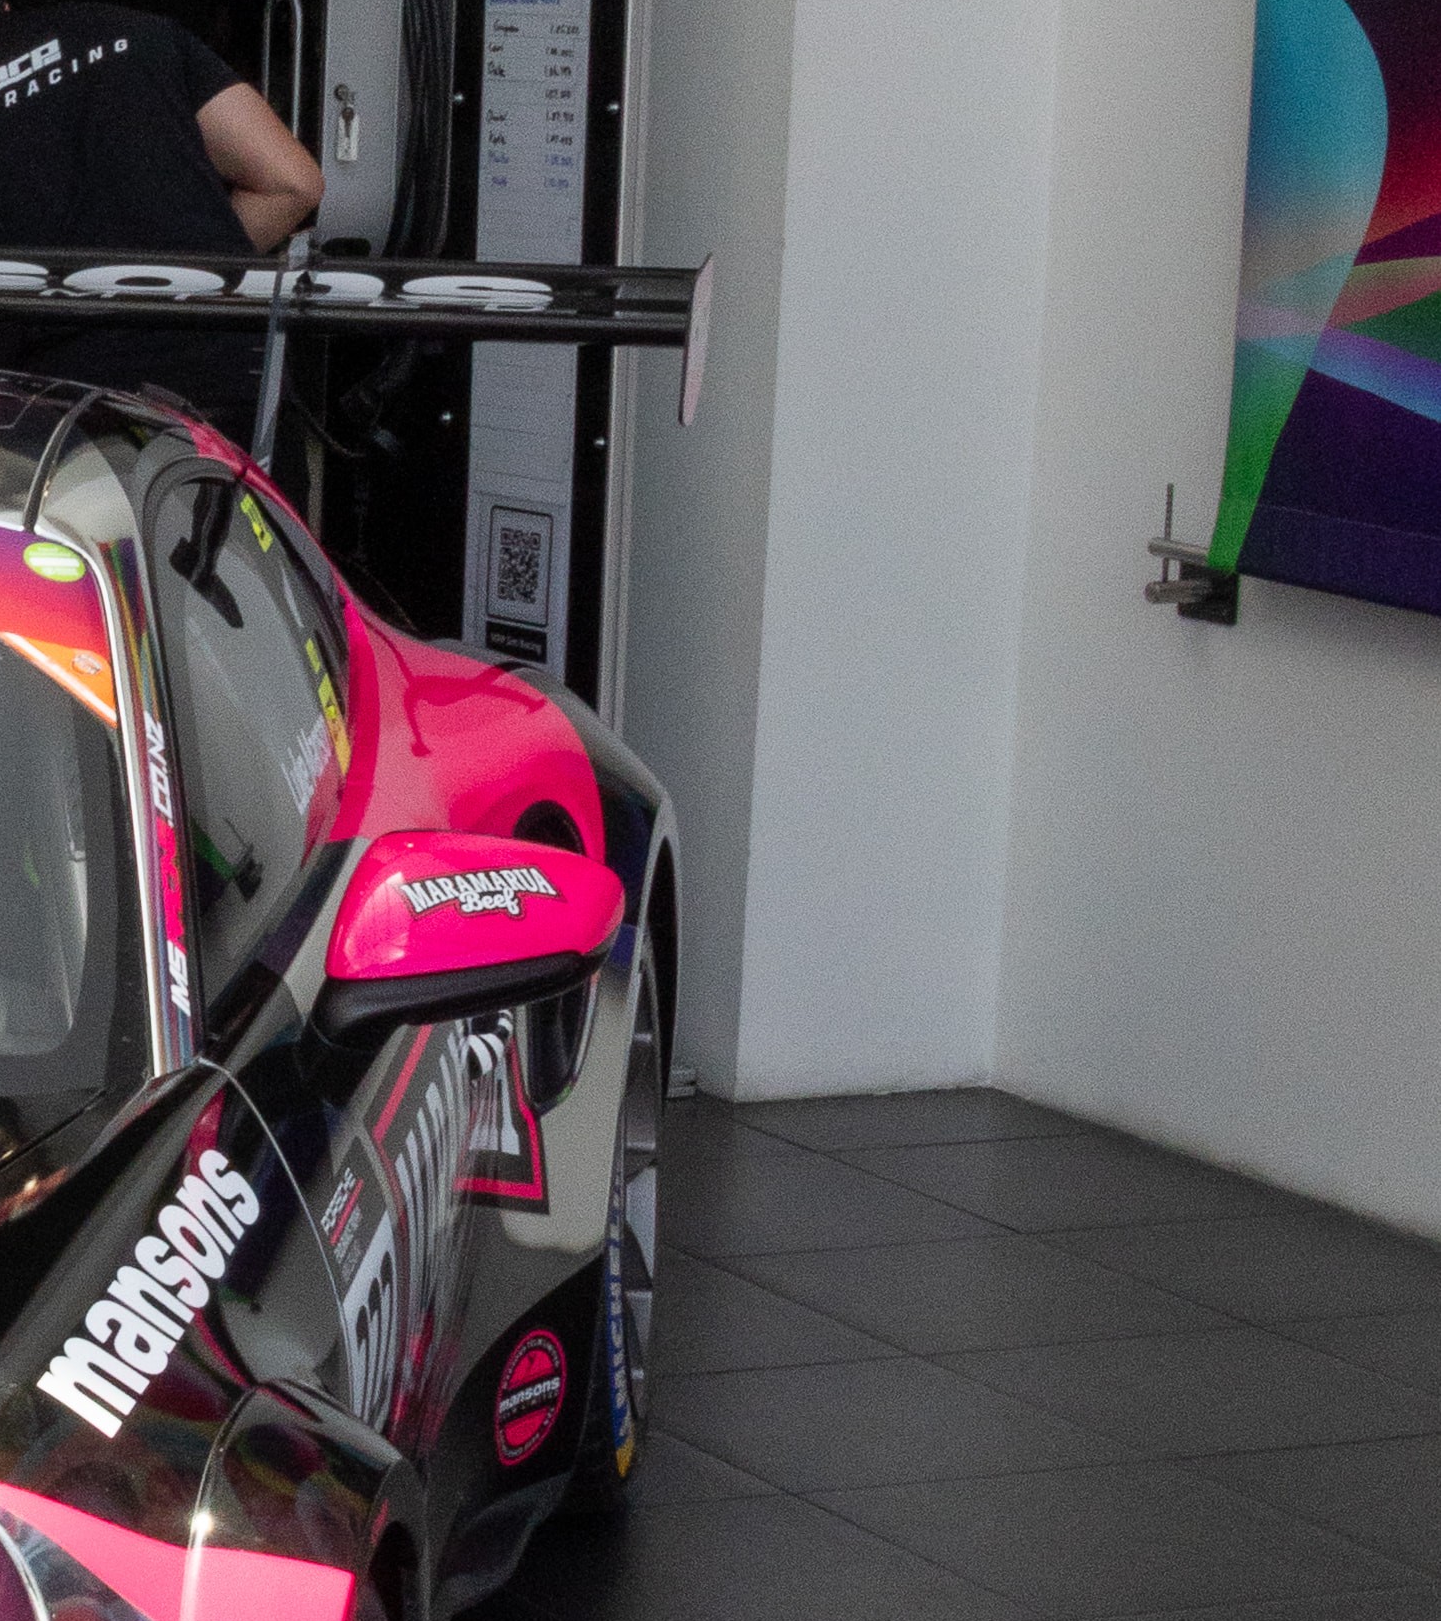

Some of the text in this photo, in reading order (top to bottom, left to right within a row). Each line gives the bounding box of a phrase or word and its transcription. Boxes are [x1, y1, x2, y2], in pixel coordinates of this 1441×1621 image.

[4, 38, 128, 107] RACING
[400, 866, 559, 912] MARAMARUA
[459, 888, 522, 915] Beef
[36, 1149, 262, 1438] mansons
[498, 1376, 561, 1415] mansons
